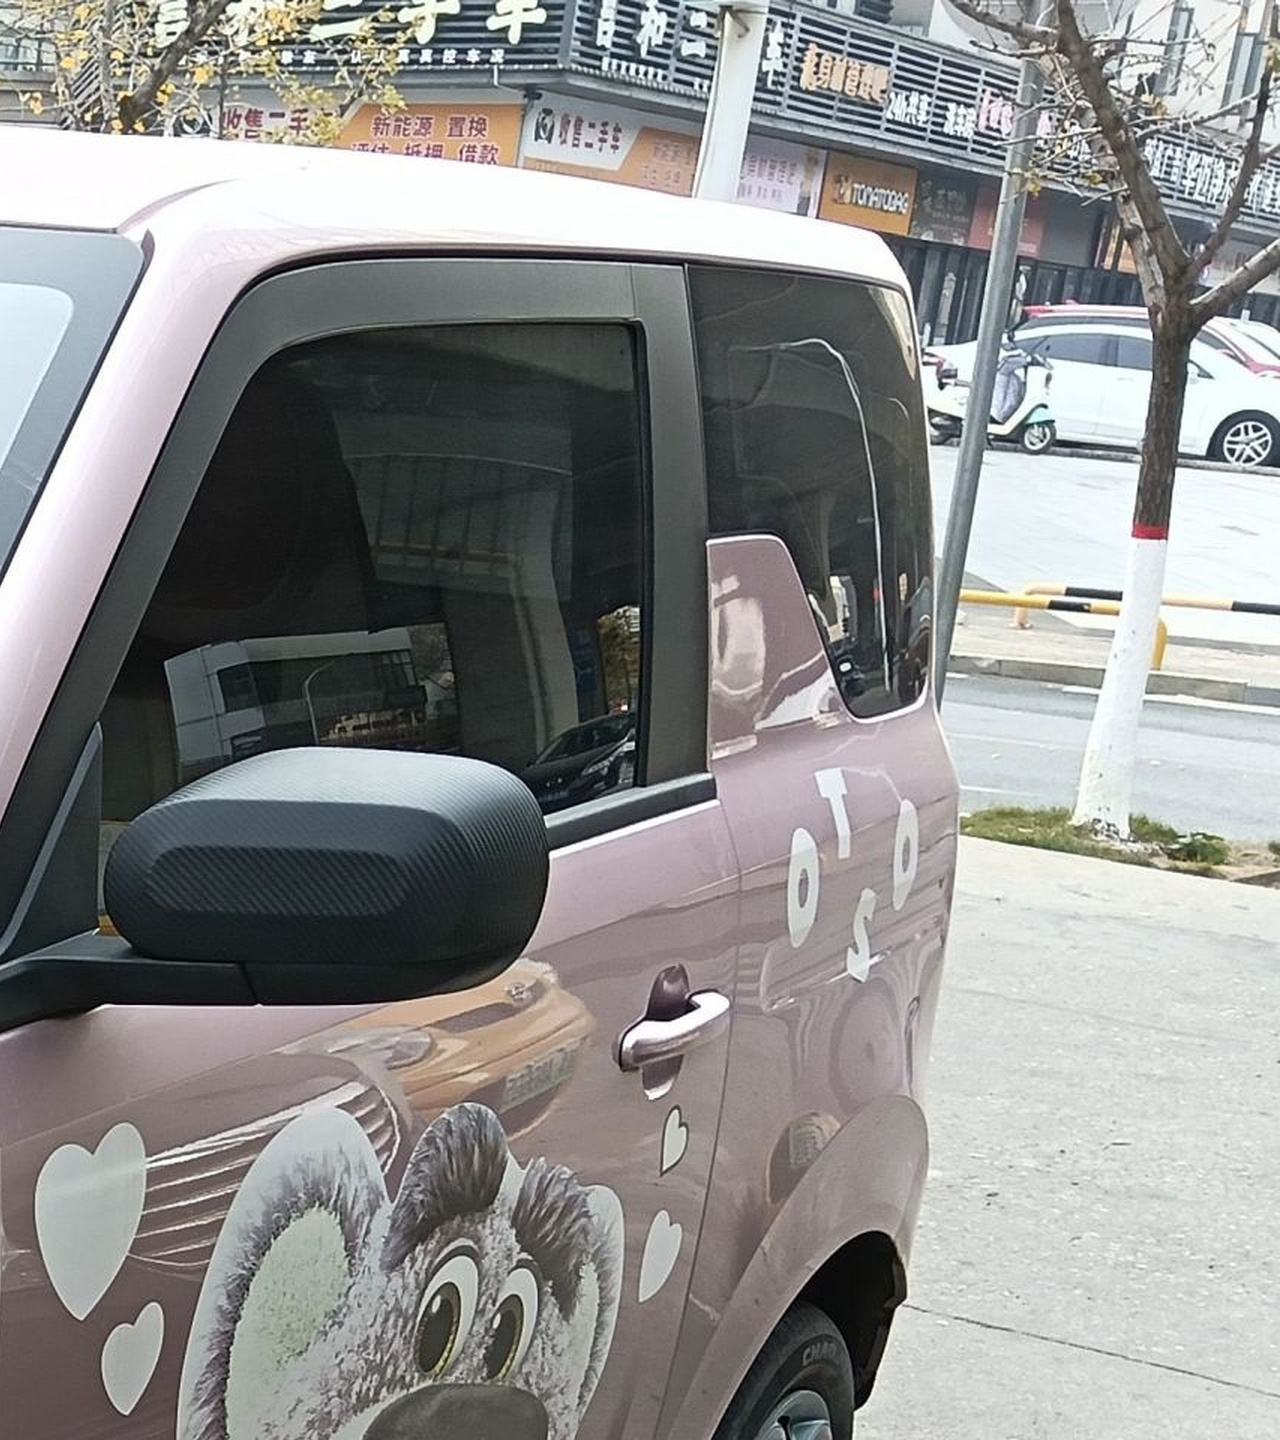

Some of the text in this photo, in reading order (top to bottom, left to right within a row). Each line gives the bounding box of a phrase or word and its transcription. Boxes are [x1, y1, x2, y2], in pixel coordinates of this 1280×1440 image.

[372, 115, 488, 138] 新能源 置换
